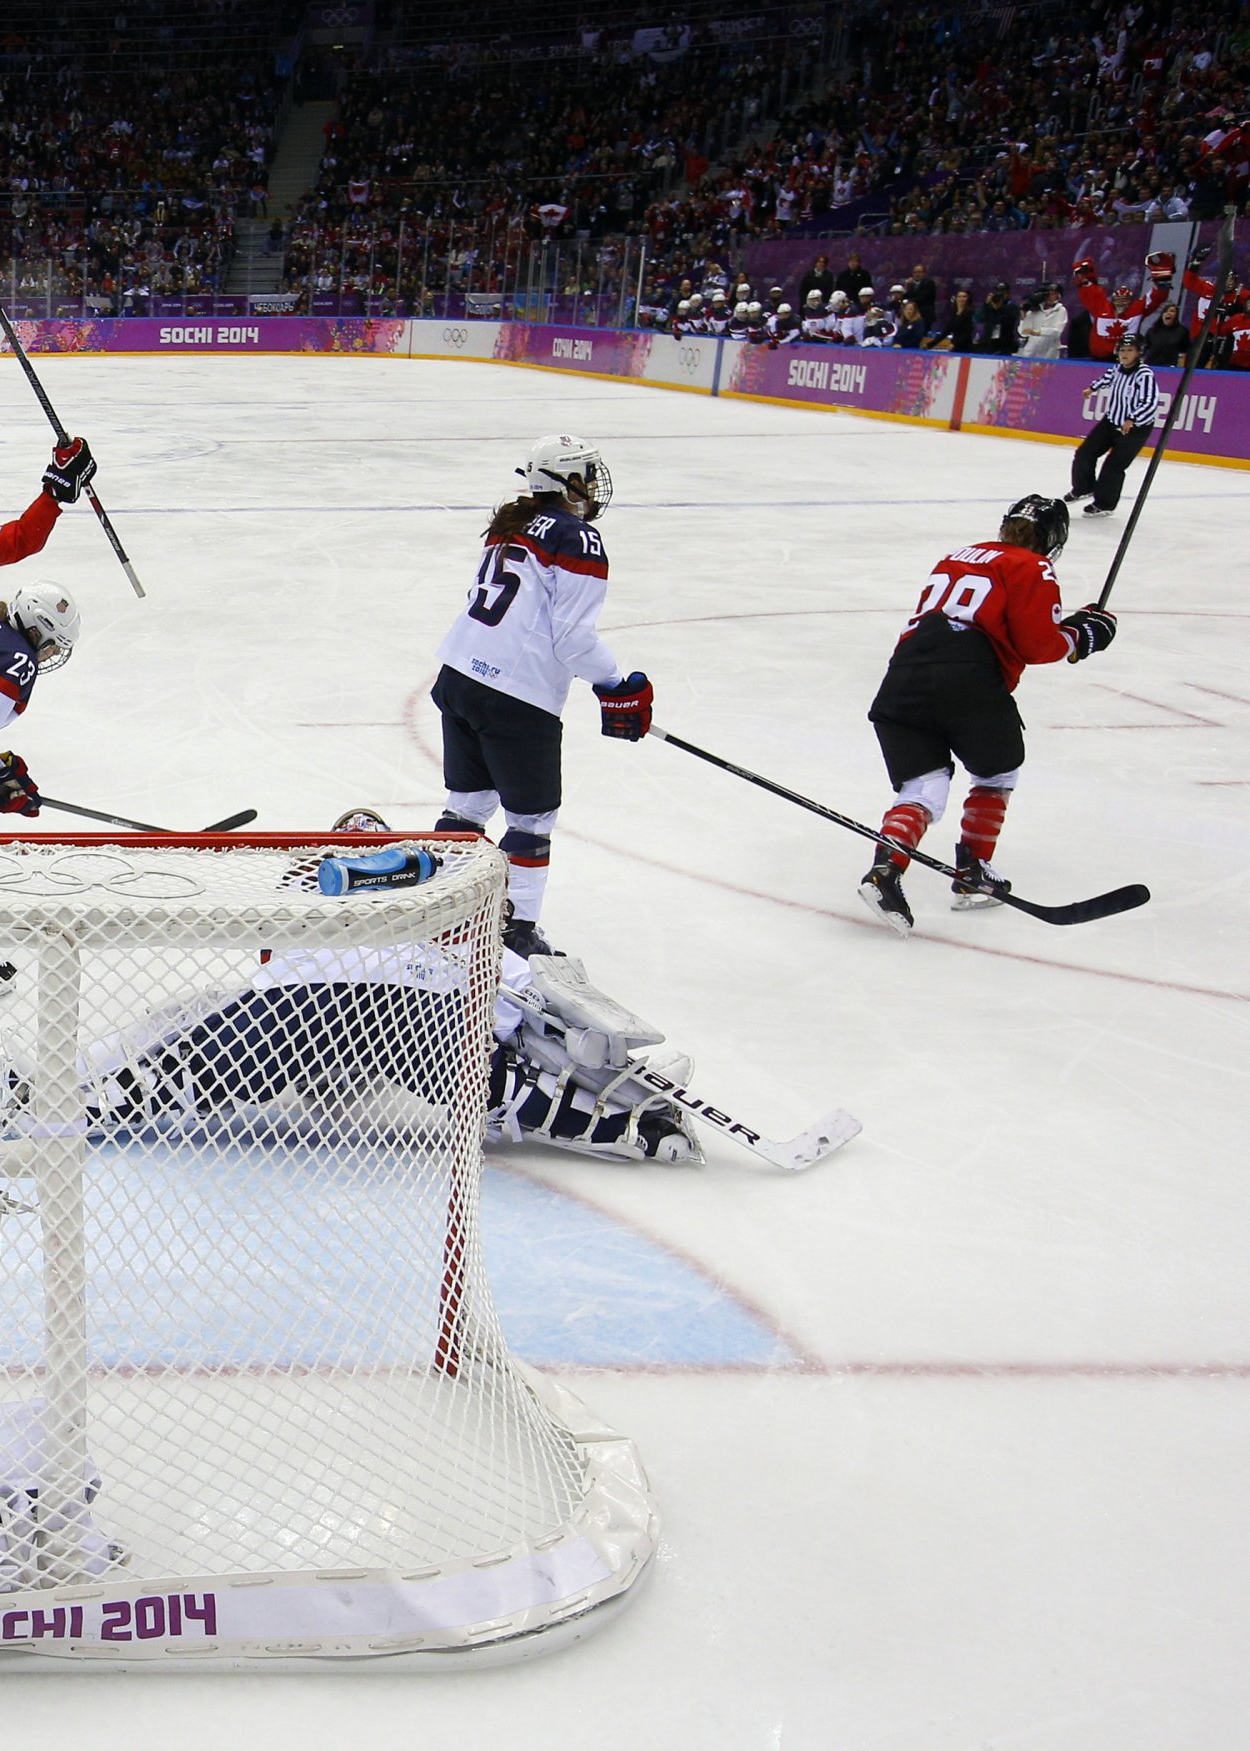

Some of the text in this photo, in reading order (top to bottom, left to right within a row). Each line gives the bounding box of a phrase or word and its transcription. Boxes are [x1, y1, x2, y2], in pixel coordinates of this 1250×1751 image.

[159, 327, 259, 344] SOCHI 2014
[573, 339, 593, 361] 2014
[787, 359, 867, 394] SOCHI 2014
[578, 530, 601, 556] 15
[6, 652, 35, 686] 23
[471, 657, 502, 675] sochi.ru
[600, 700, 640, 709] BAUER
[353, 872, 417, 887] SPORTS DRINK
[100, 1593, 218, 1642] 2014
